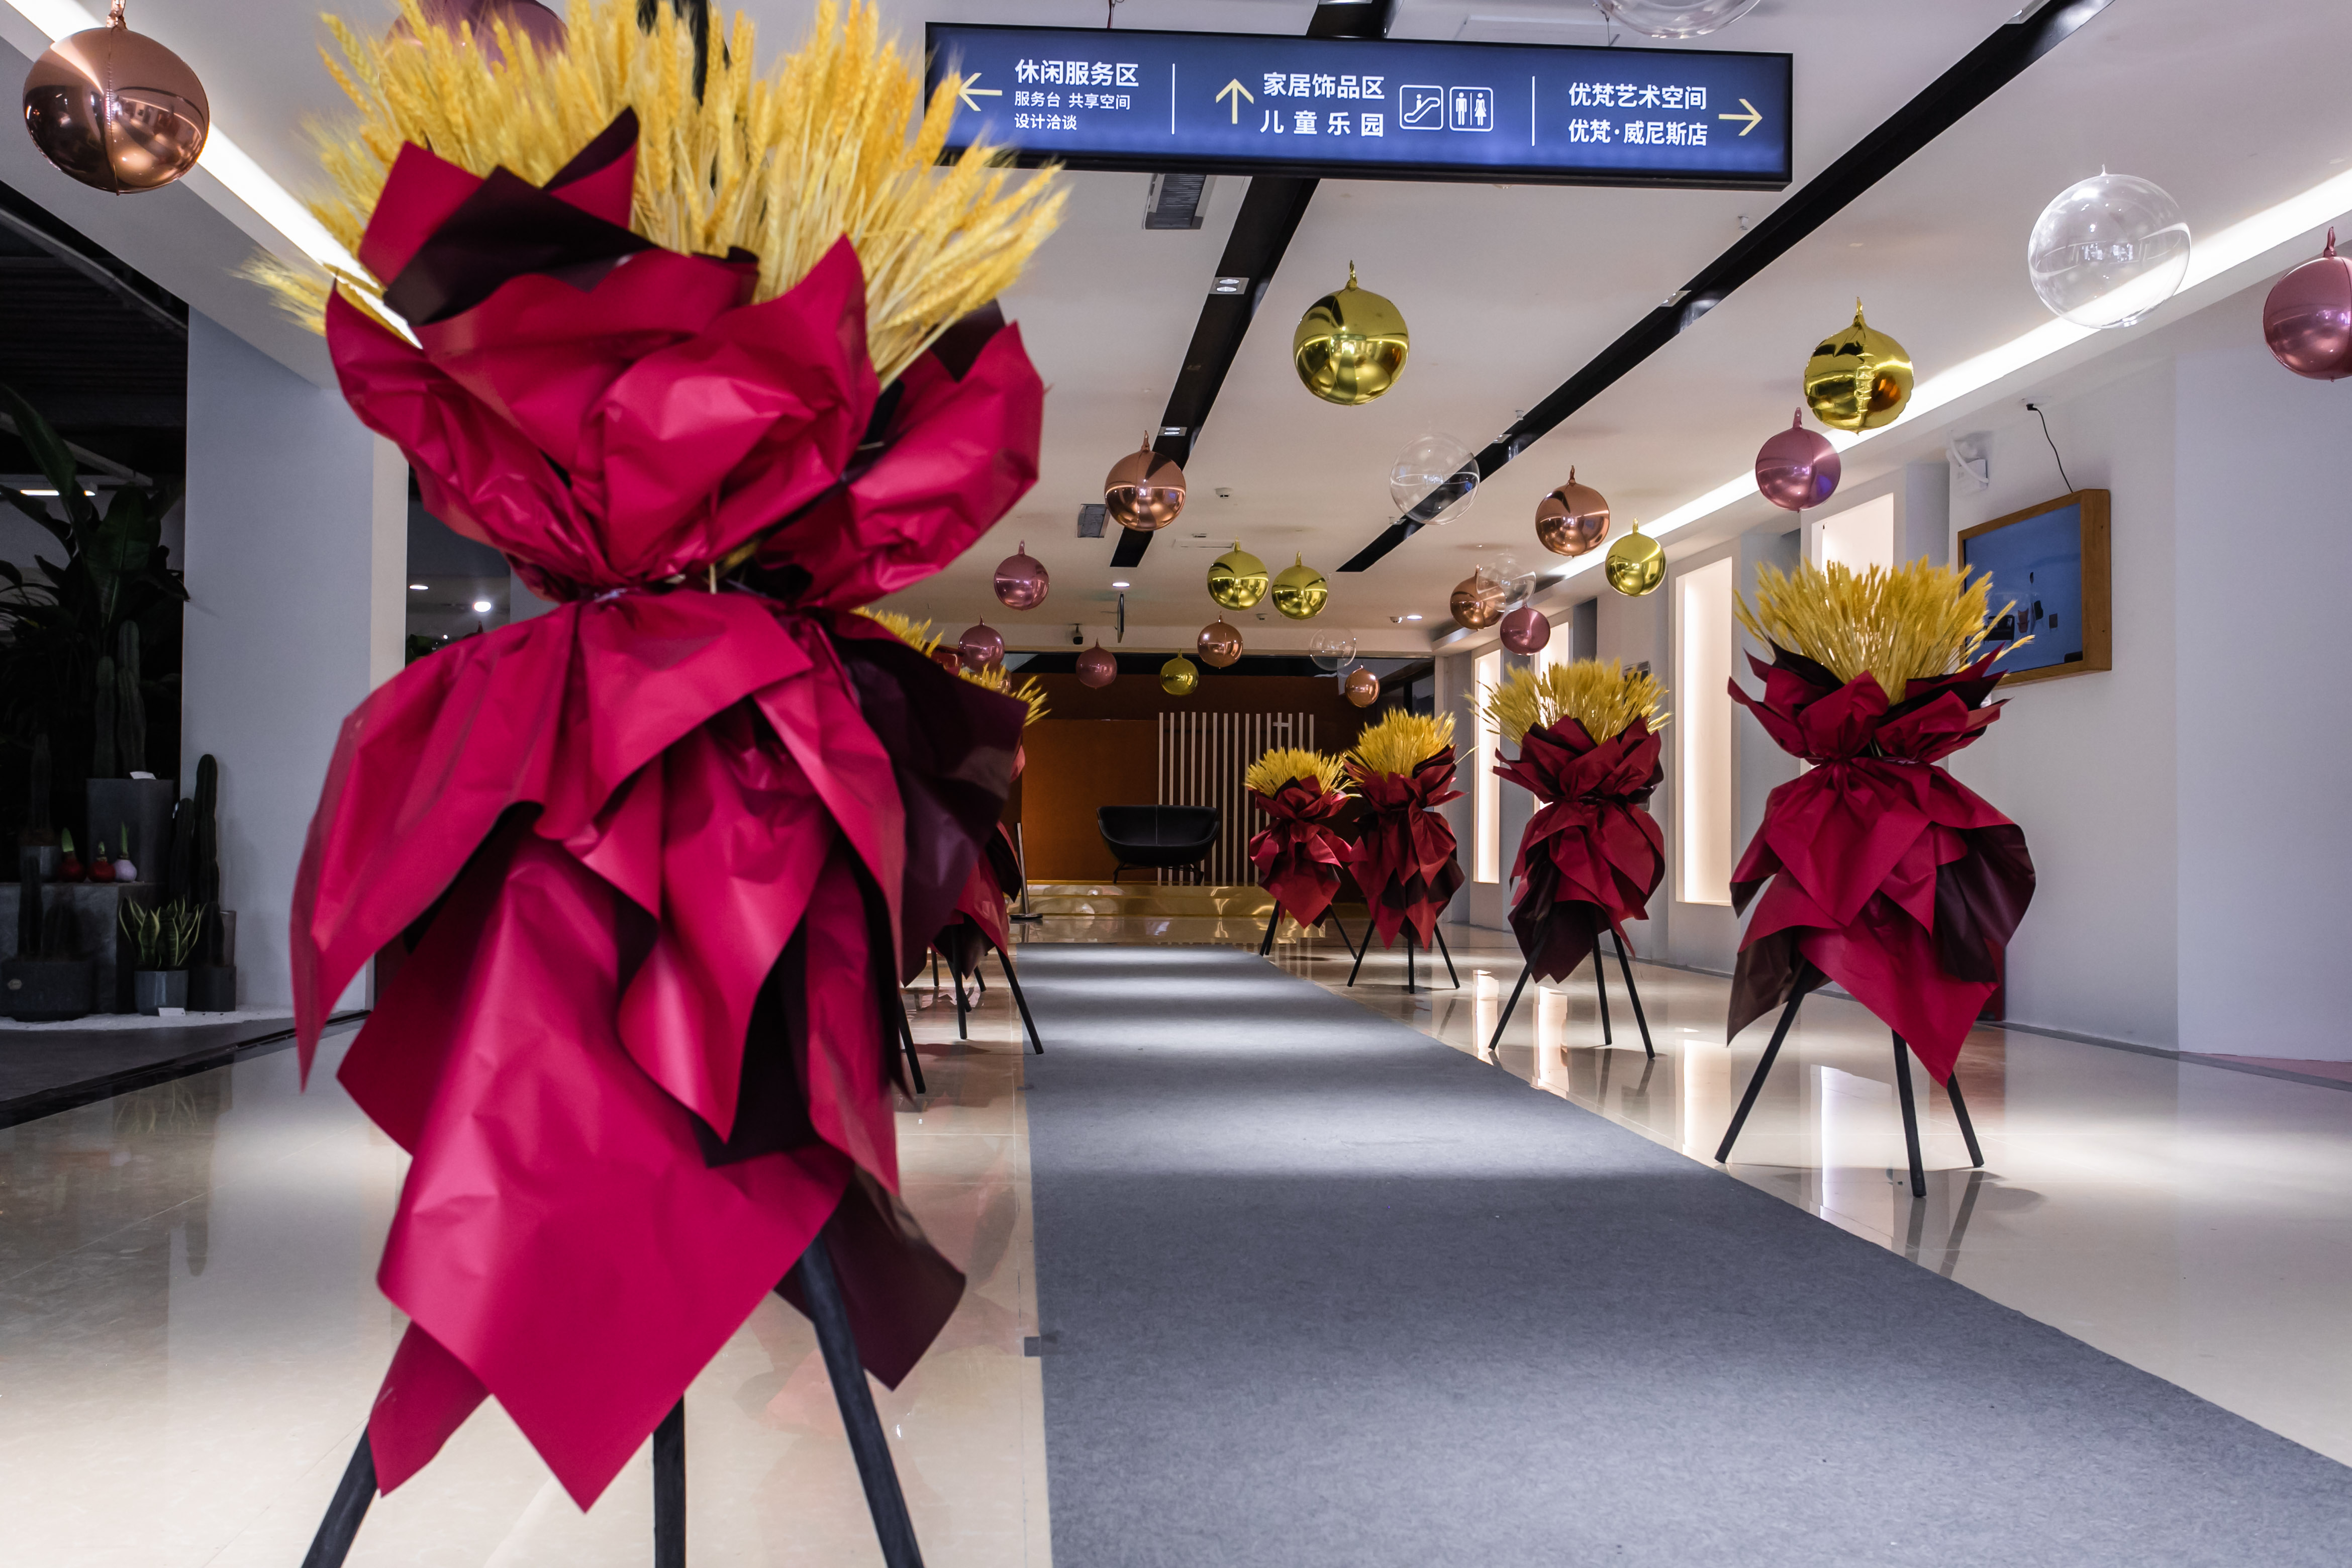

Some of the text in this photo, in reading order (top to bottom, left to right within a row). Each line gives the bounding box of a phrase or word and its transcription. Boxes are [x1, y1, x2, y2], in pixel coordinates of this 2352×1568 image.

[1015, 59, 1139, 87] 休闲服务区
[1263, 72, 1385, 100] 家居饰品区
[1014, 91, 1130, 111] 服务台 共享空间
[1569, 82, 1707, 110] 优梵艺术空间
[1014, 113, 1077, 131] 设计洽谈
[1260, 110, 1384, 138] 儿童乐园
